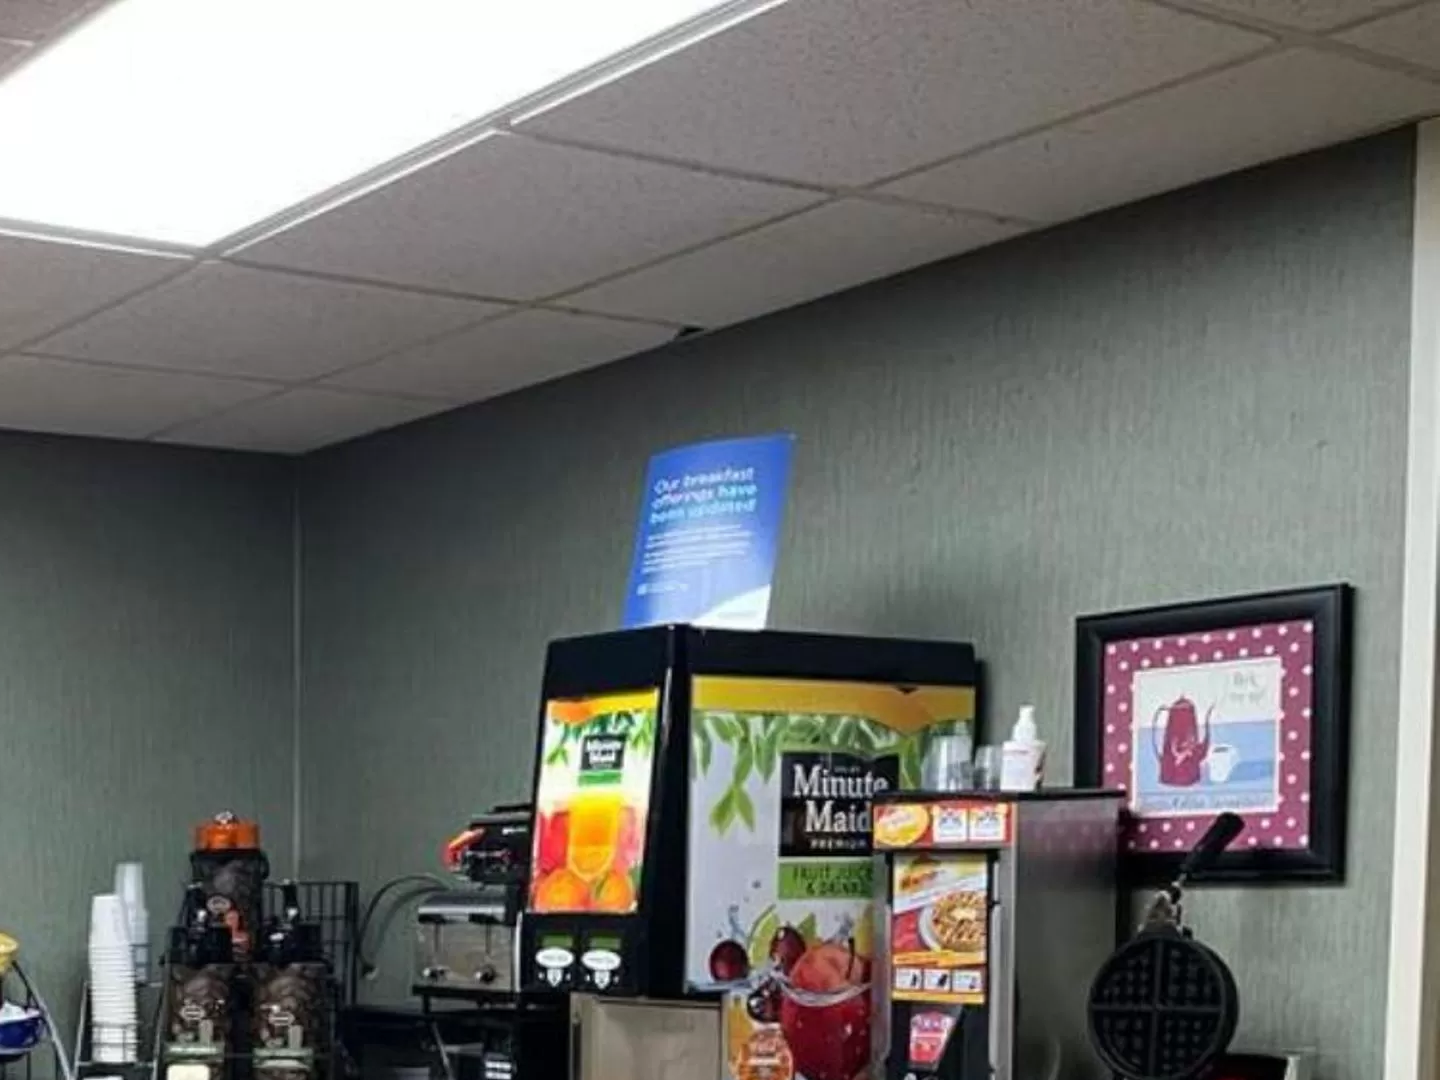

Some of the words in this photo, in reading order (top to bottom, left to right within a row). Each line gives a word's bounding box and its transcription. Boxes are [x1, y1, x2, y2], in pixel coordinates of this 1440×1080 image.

[684, 467, 754, 488] breakfast
[792, 763, 889, 798] Minute
[805, 799, 872, 833] Maid
